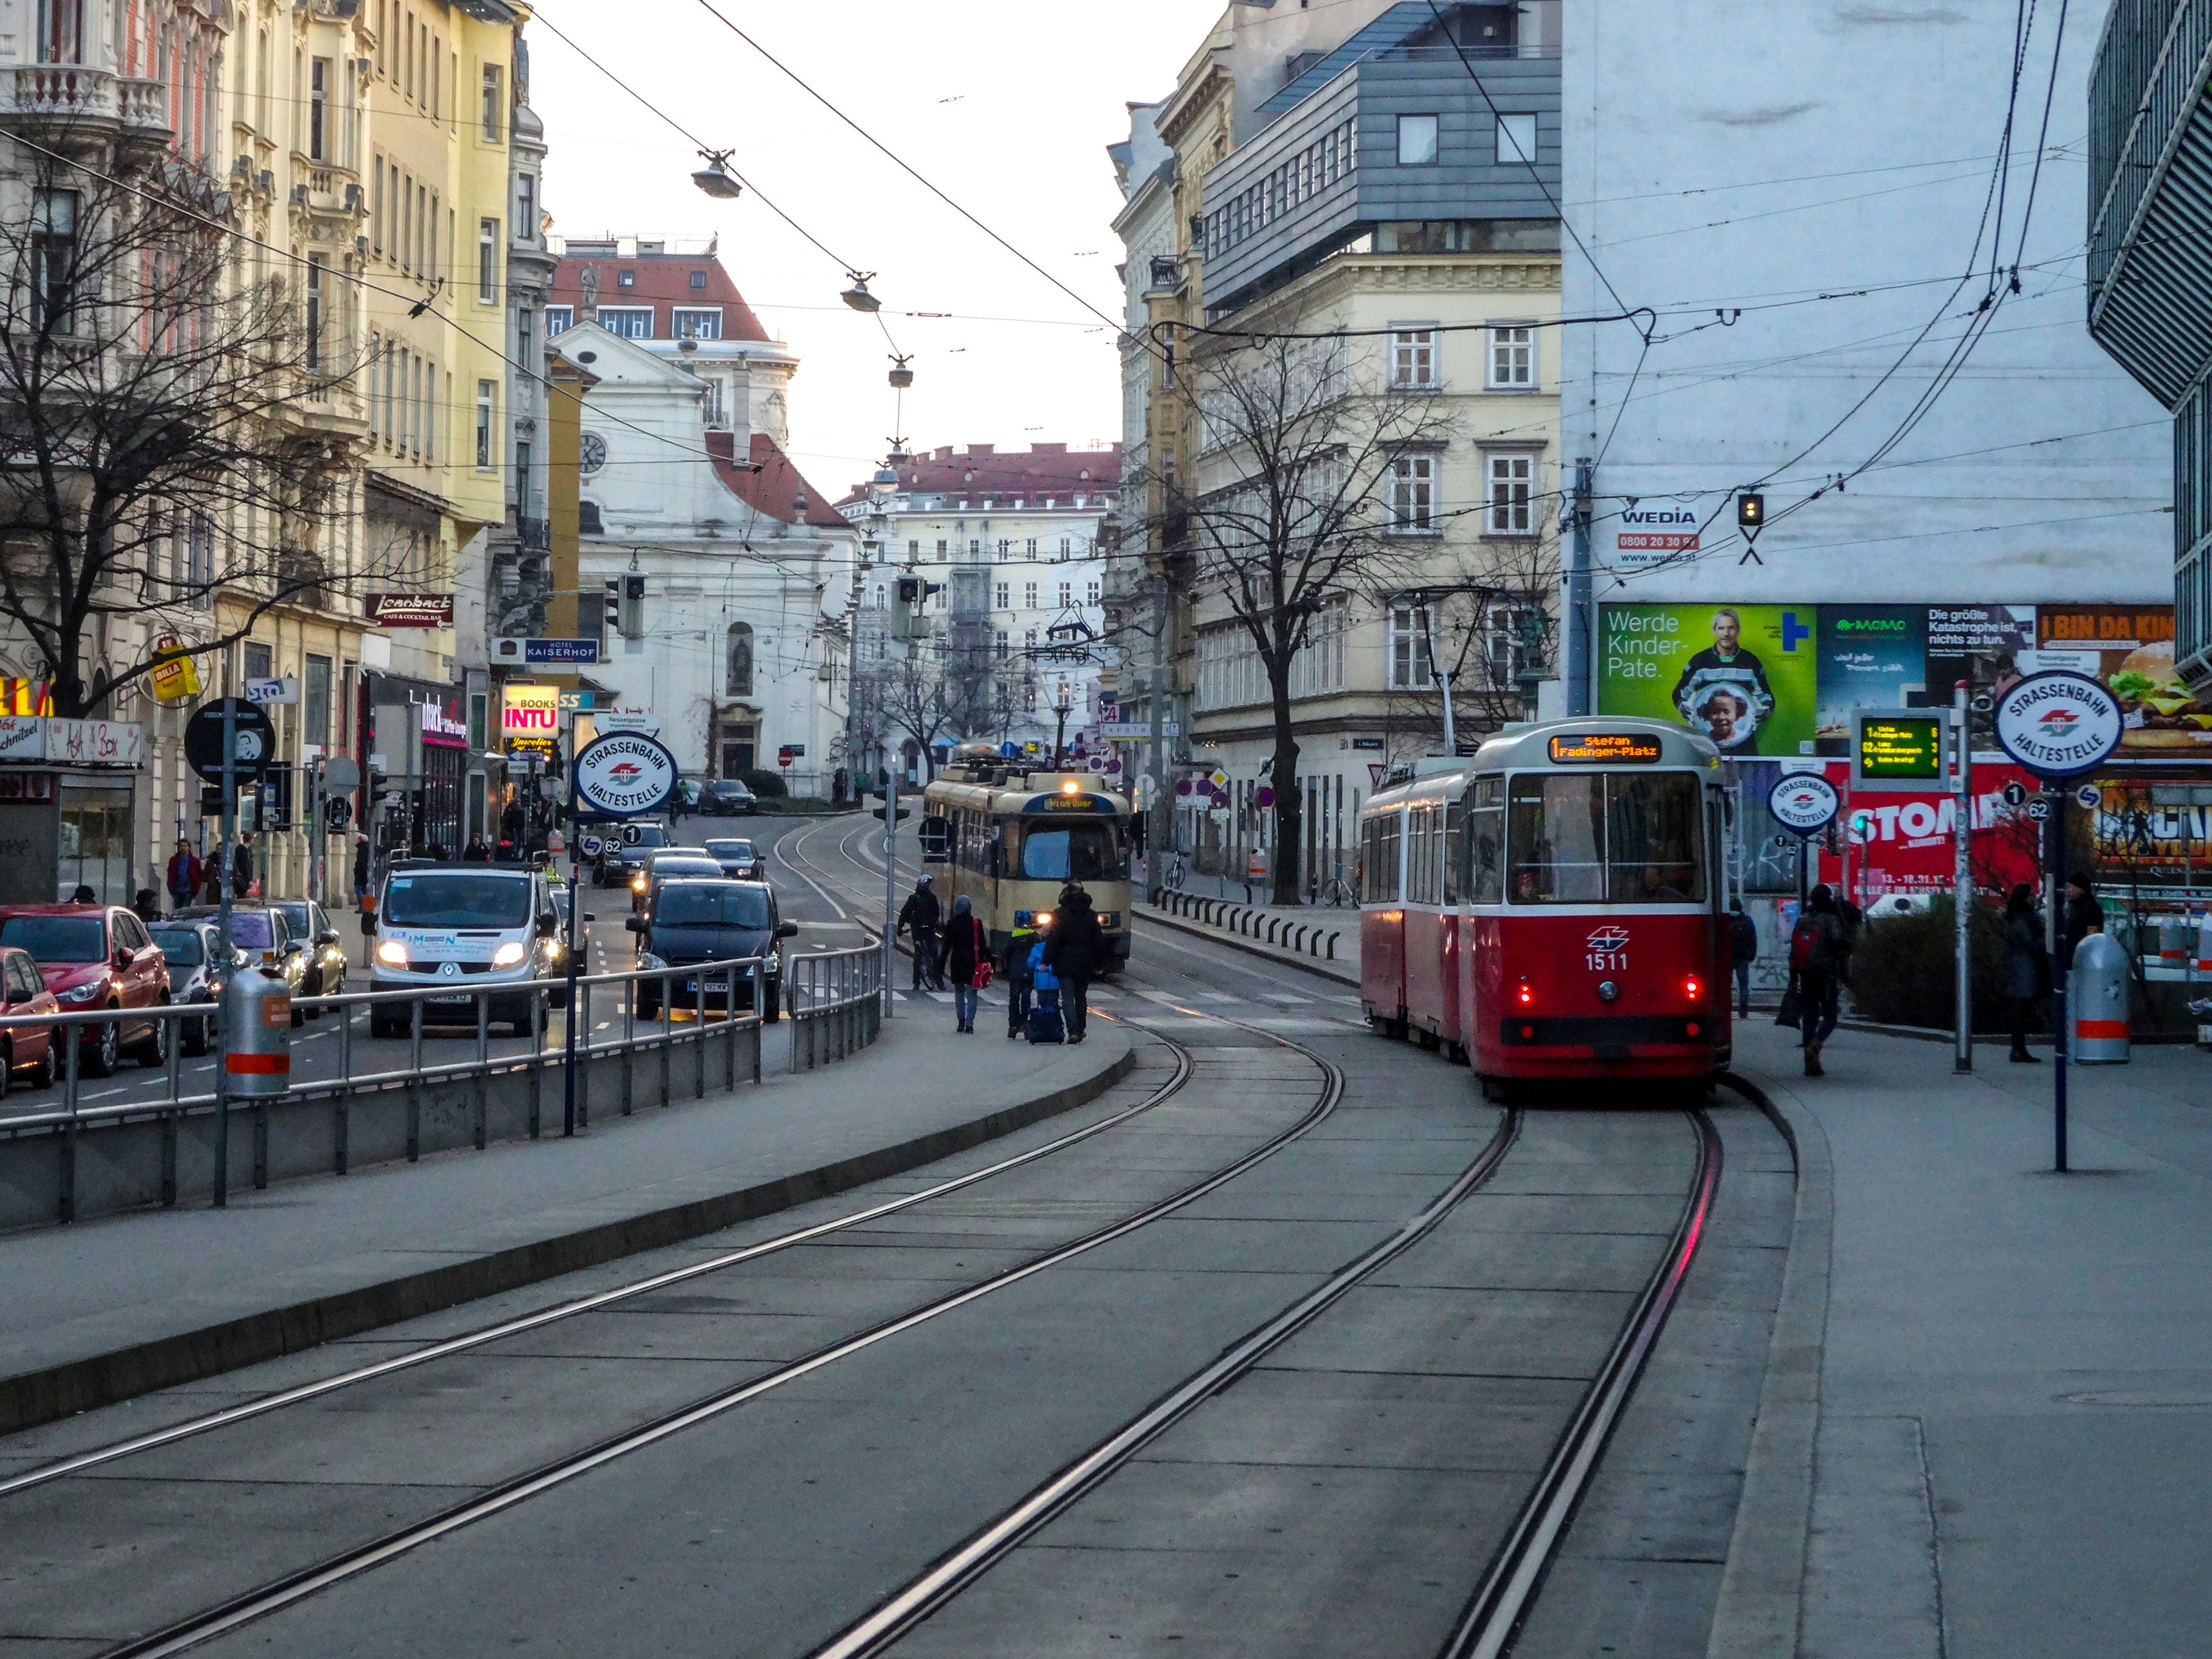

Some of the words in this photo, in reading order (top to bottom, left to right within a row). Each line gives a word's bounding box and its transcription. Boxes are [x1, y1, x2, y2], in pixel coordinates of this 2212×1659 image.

[1620, 537, 1647, 546] 0800
[1650, 537, 1663, 546] 20
[1667, 537, 1679, 546] 30
[1608, 612, 1678, 632] Werde
[1928, 609, 1948, 619] Die
[1950, 609, 1988, 622] größte
[1929, 622, 1999, 634] Katastrophe
[2000, 622, 2017, 634] ist,
[2042, 615, 2049, 638] I
[2054, 615, 2094, 638] BIN
[2100, 615, 2131, 638] DA
[1609, 635, 1688, 655] Kinder-
[1929, 634, 1964, 644] nichts
[1983, 635, 2006, 644] tun.
[156, 664, 181, 681] BILLA
[1609, 658, 1662, 677] Pate.
[520, 700, 556, 708] BOOKS
[2009, 684, 2110, 718] STRASSENBAHN
[505, 709, 555, 728] INTU
[1867, 727, 1872, 738] 1
[1552, 737, 1558, 758] 1
[1585, 737, 1630, 745] Stefan
[1559, 747, 1657, 757] Fadinger-Platz
[2013, 733, 2105, 761] HALTESTELLE
[586, 742, 666, 770] STRASSENBAHN
[588, 782, 662, 806] HALTESTELLE
[1777, 780, 1832, 799] STRASSENBAHN
[2009, 787, 2018, 803] 1
[1780, 807, 1829, 823] HALTESTELLE
[2028, 803, 2048, 817] 62
[628, 828, 635, 842] 1
[1777, 837, 1783, 846] 1
[605, 841, 620, 852] 62
[1854, 885, 1883, 895] HLLE
[1585, 953, 1627, 971] 1511
